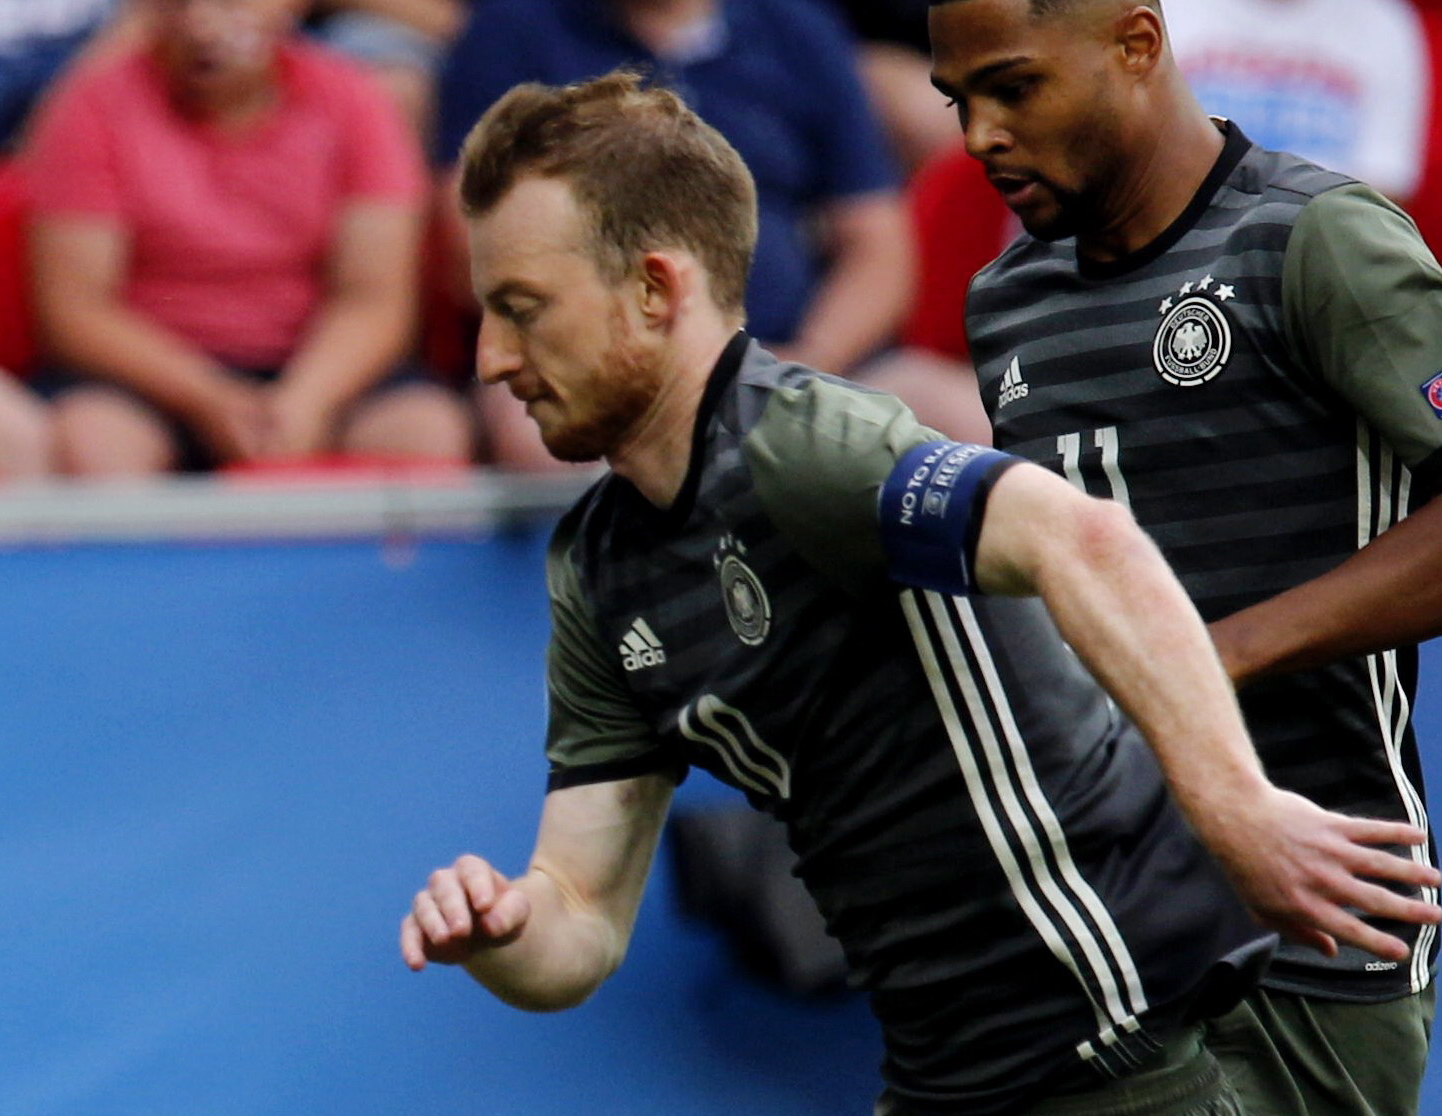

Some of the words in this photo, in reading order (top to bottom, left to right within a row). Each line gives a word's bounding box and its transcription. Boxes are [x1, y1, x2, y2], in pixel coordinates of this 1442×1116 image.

[907, 465, 930, 489] TO
[1056, 425, 1132, 515] 11
[900, 492, 917, 525] NO
